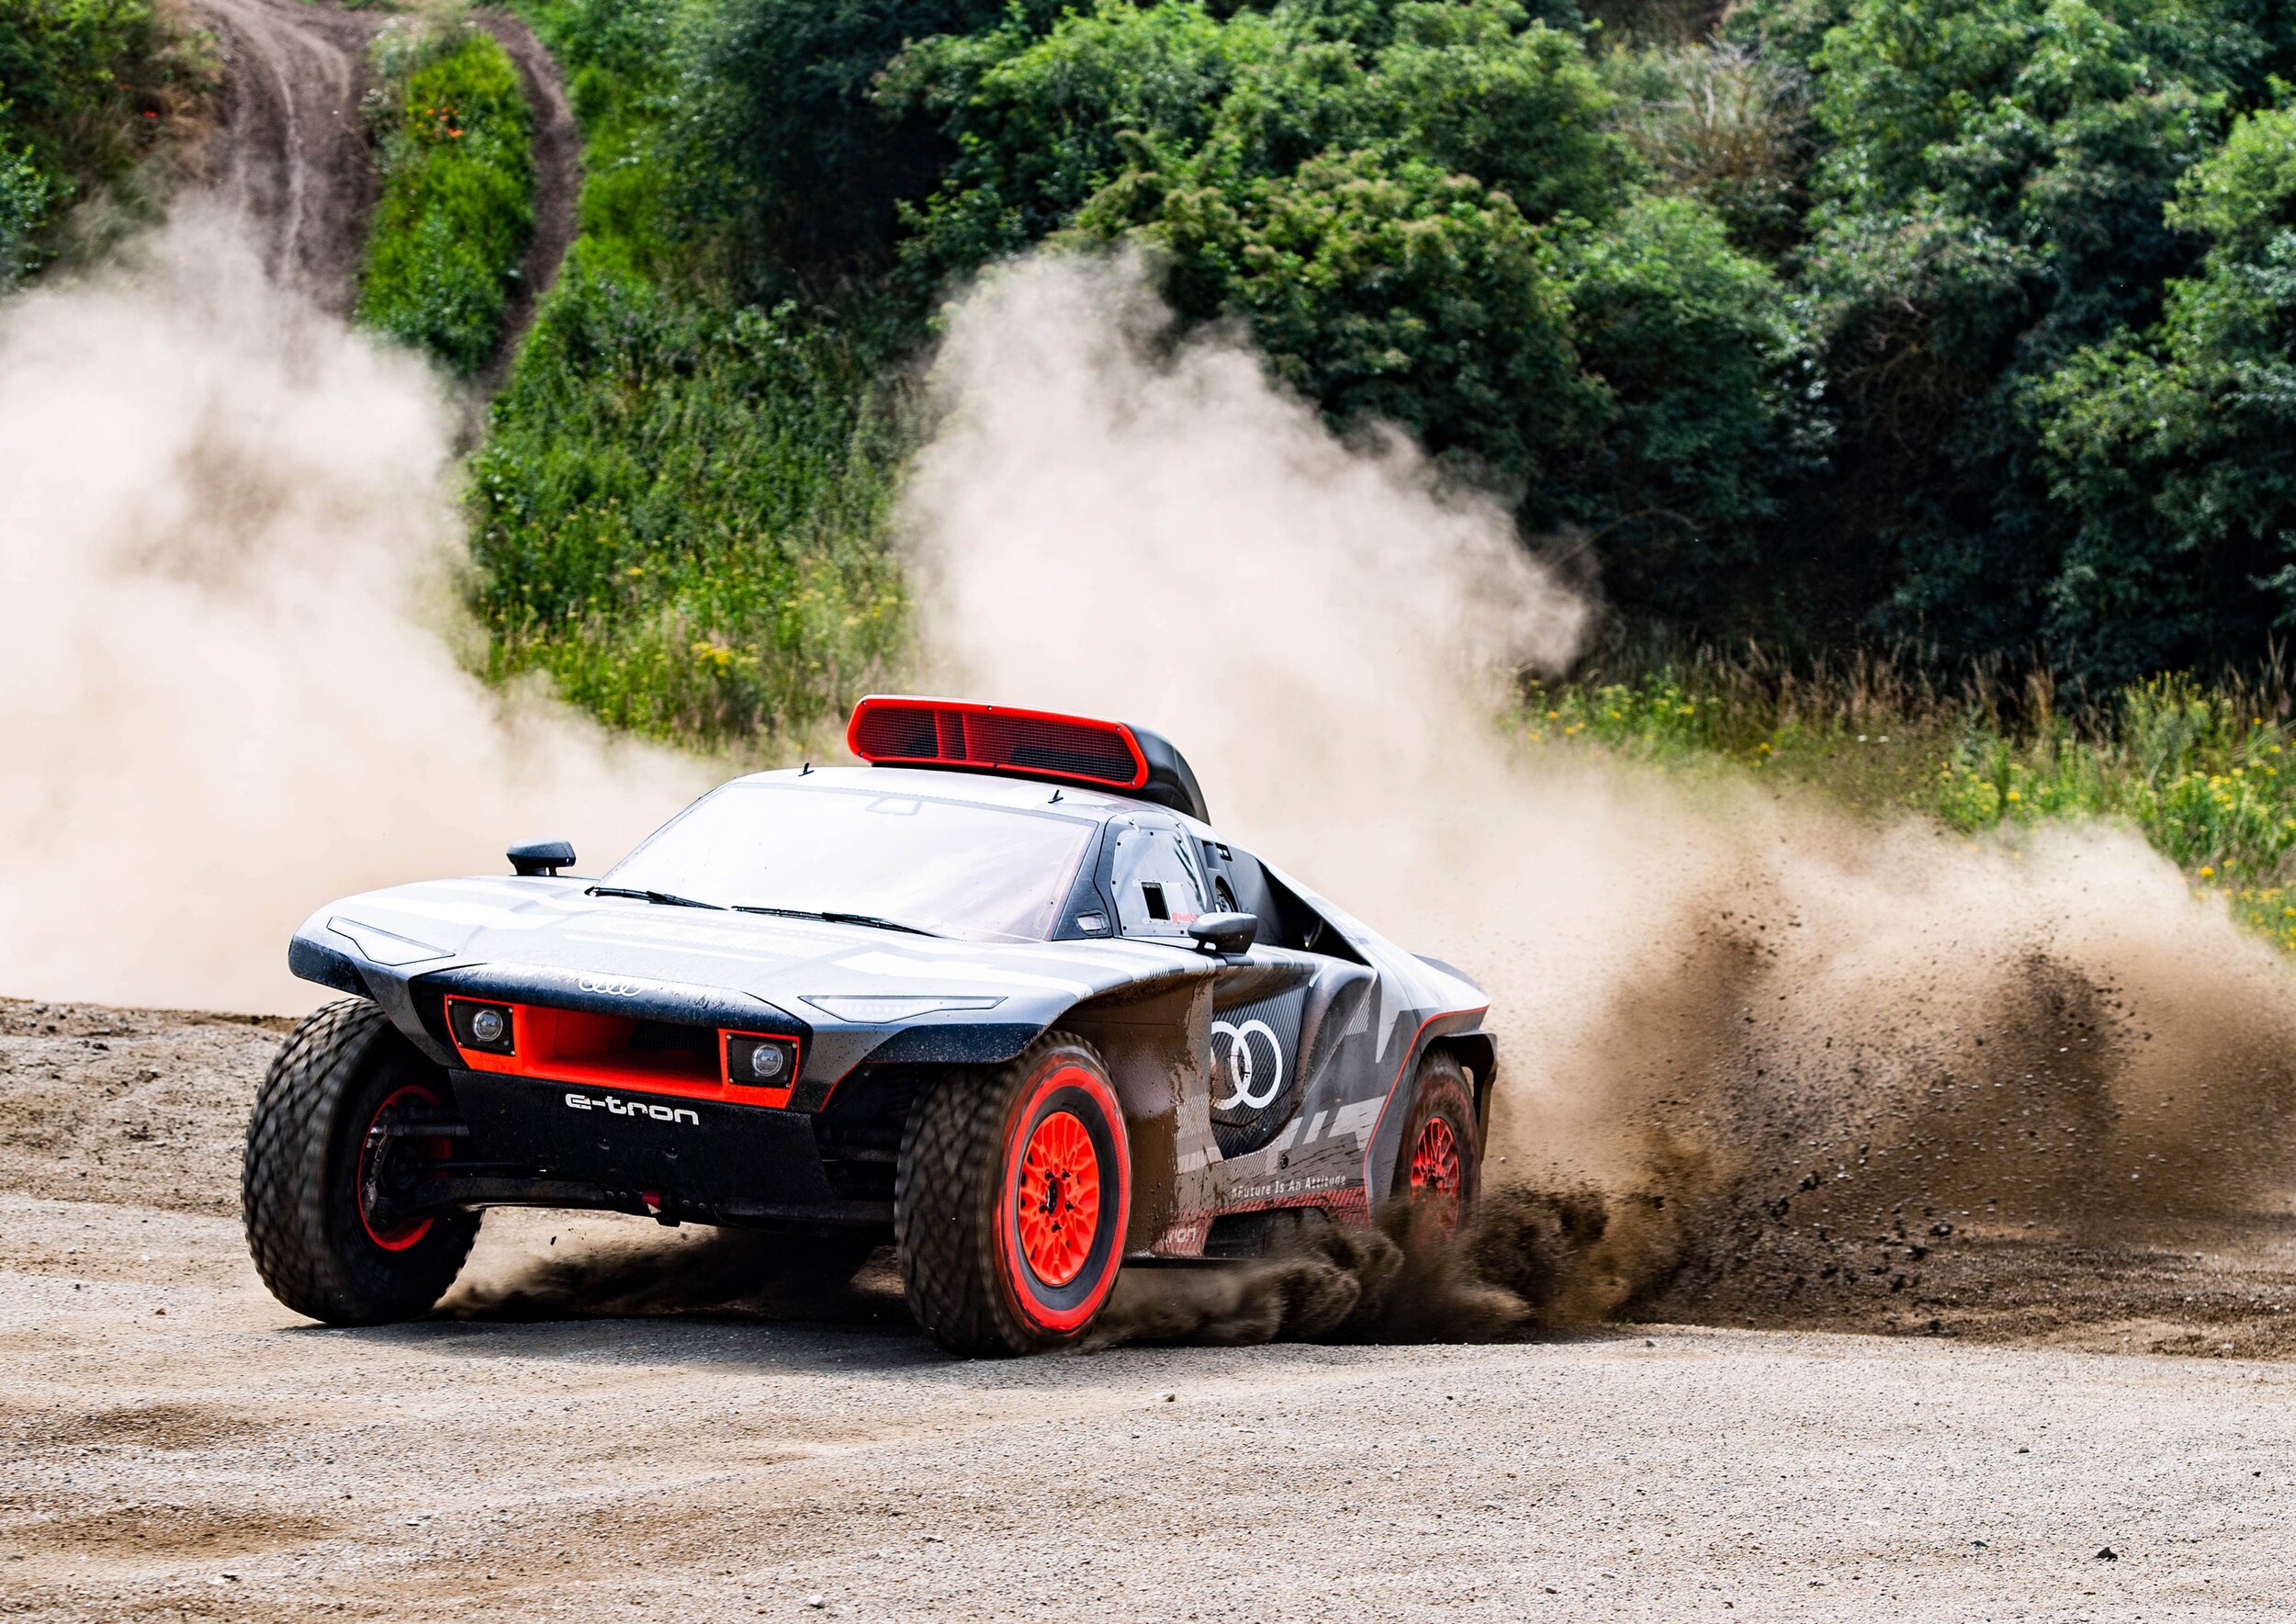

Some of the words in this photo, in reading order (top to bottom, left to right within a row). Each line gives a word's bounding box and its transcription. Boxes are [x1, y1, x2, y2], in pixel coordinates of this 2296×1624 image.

[565, 1093, 700, 1126] e-tron
[1275, 1180, 1285, 1194] Is
[1288, 1179, 1301, 1192] An
[1305, 1175, 1346, 1190] Attitude
